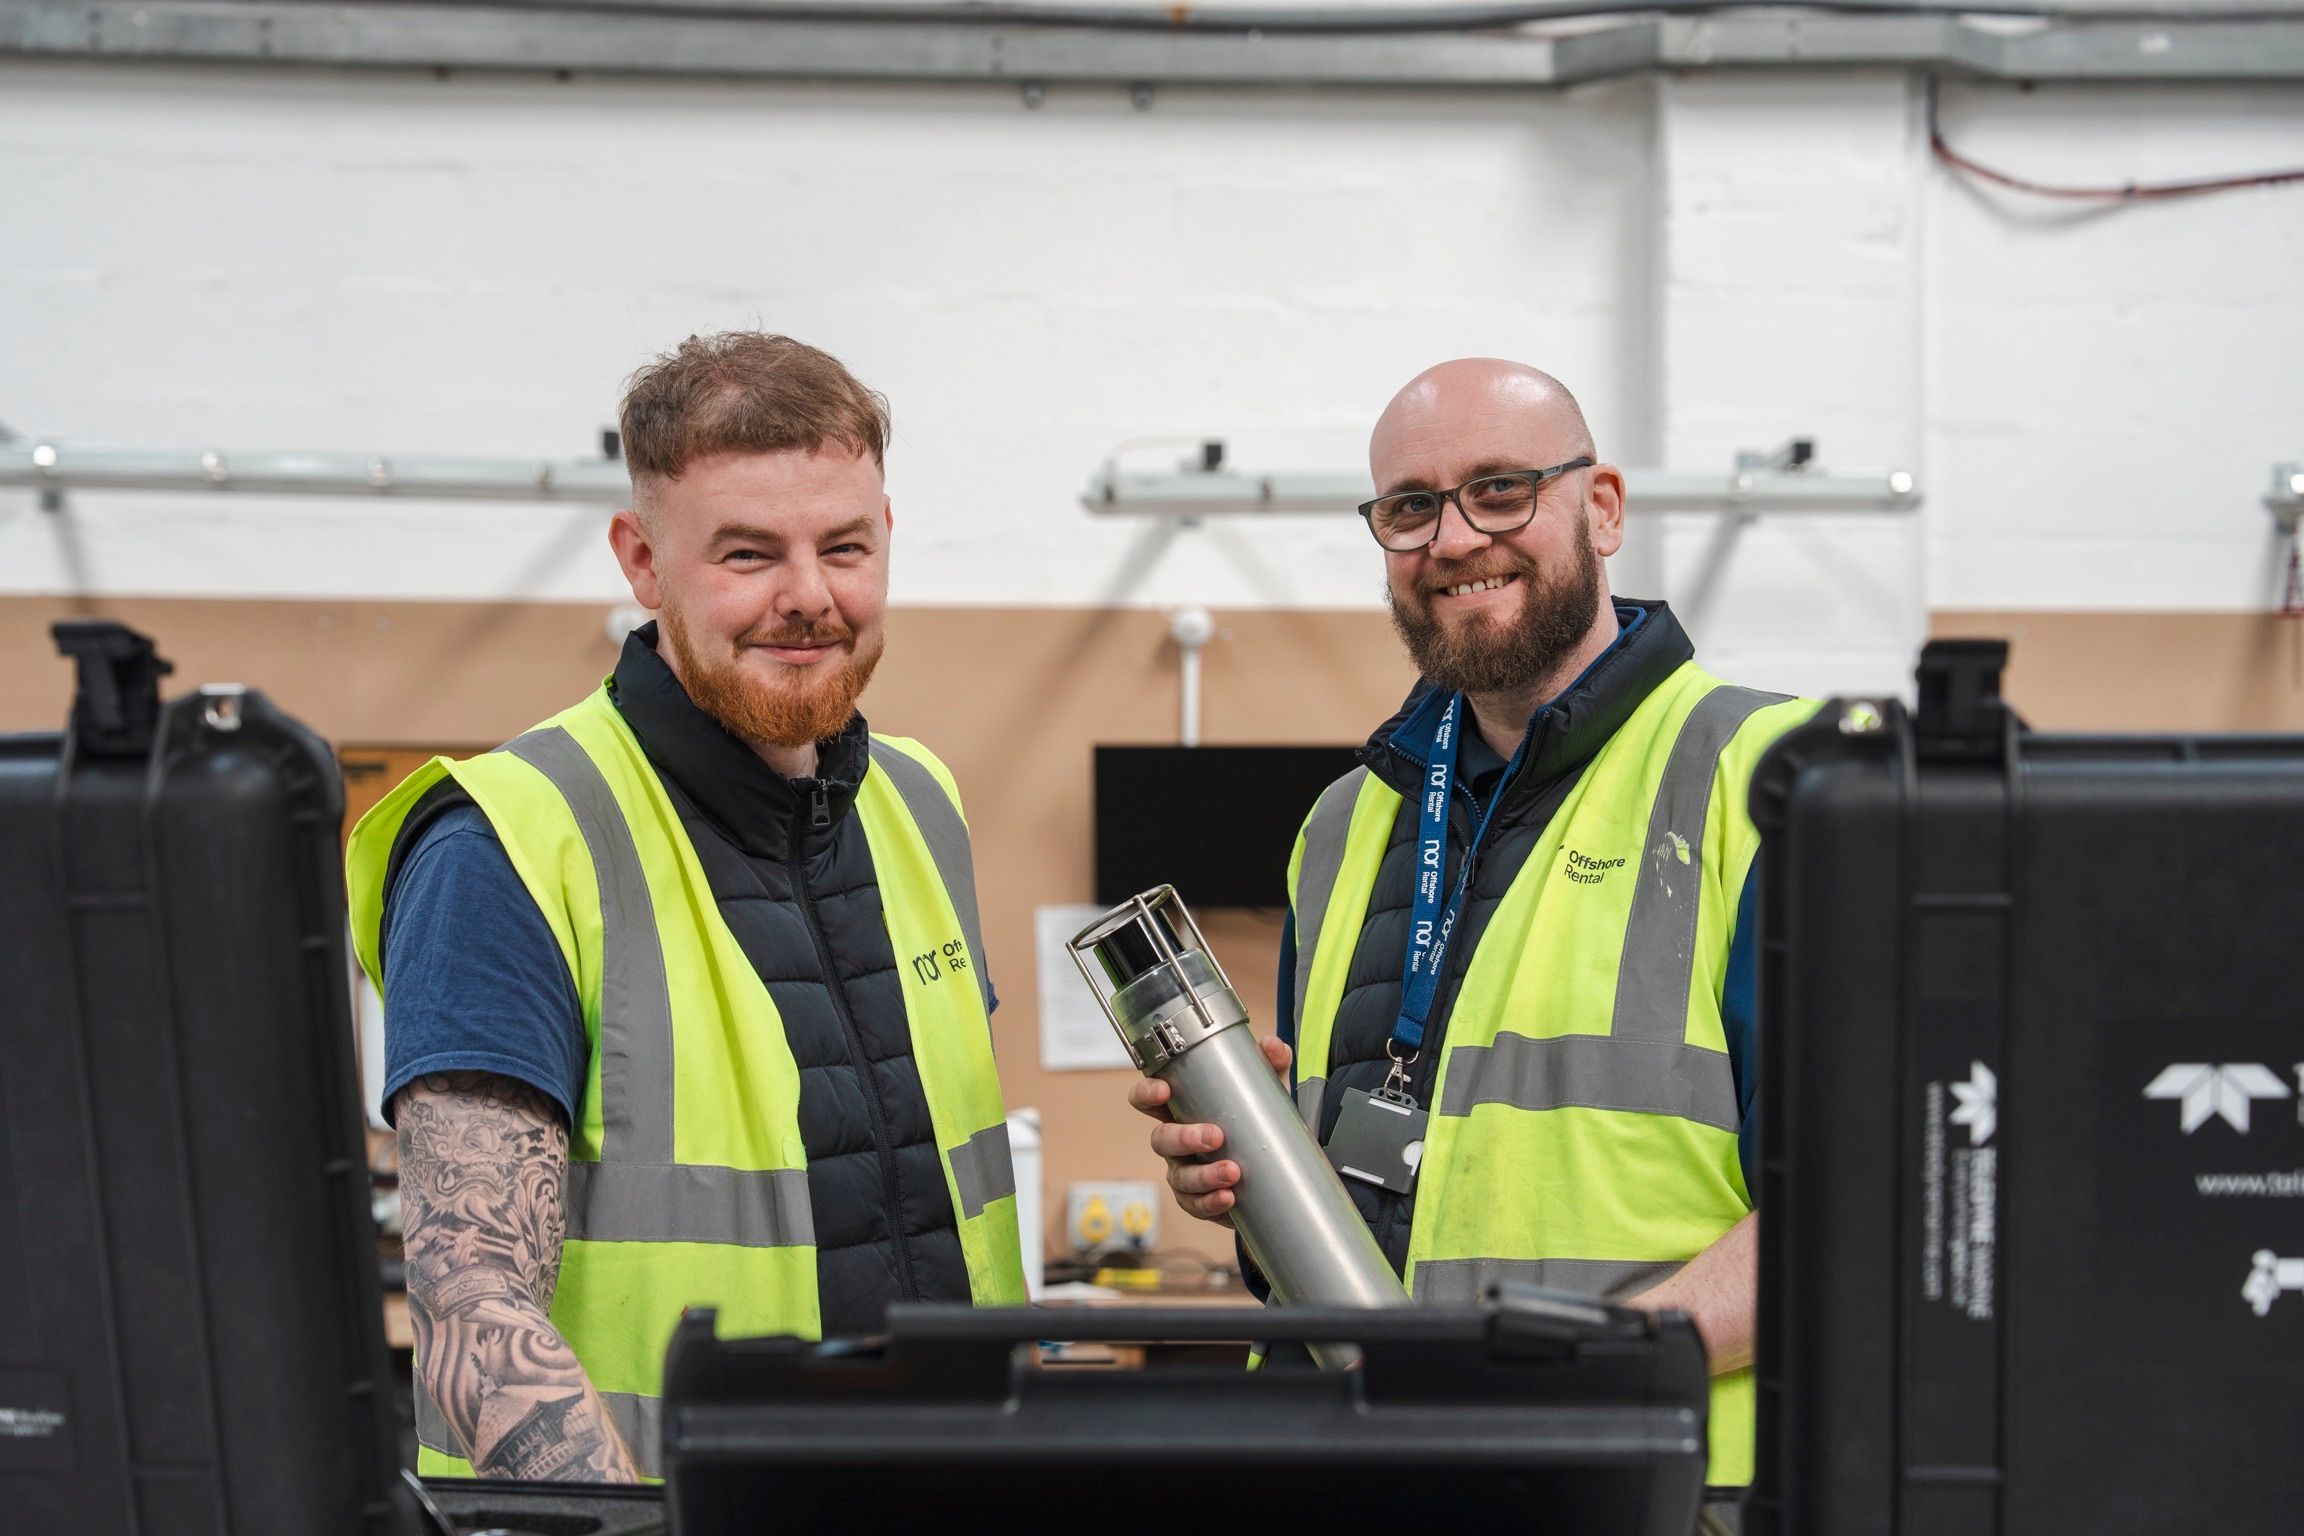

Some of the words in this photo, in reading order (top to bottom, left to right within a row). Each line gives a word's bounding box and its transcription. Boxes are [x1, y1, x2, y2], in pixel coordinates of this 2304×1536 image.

[1442, 722, 1452, 749] Offshore
[1430, 764, 1448, 789] nor
[1427, 792, 1437, 813] Rental
[1434, 791, 1445, 823] Offshore
[1423, 840, 1440, 869] nor
[1569, 850, 1626, 870] Offshore
[1420, 871, 1430, 894] Rental
[1564, 863, 1605, 884] Rental
[1427, 871, 1438, 904] Offshore
[1415, 920, 1433, 949] nor
[1442, 908, 1455, 942] nor
[1428, 939, 1442, 963] Rental
[1430, 943, 1445, 976] Offshore
